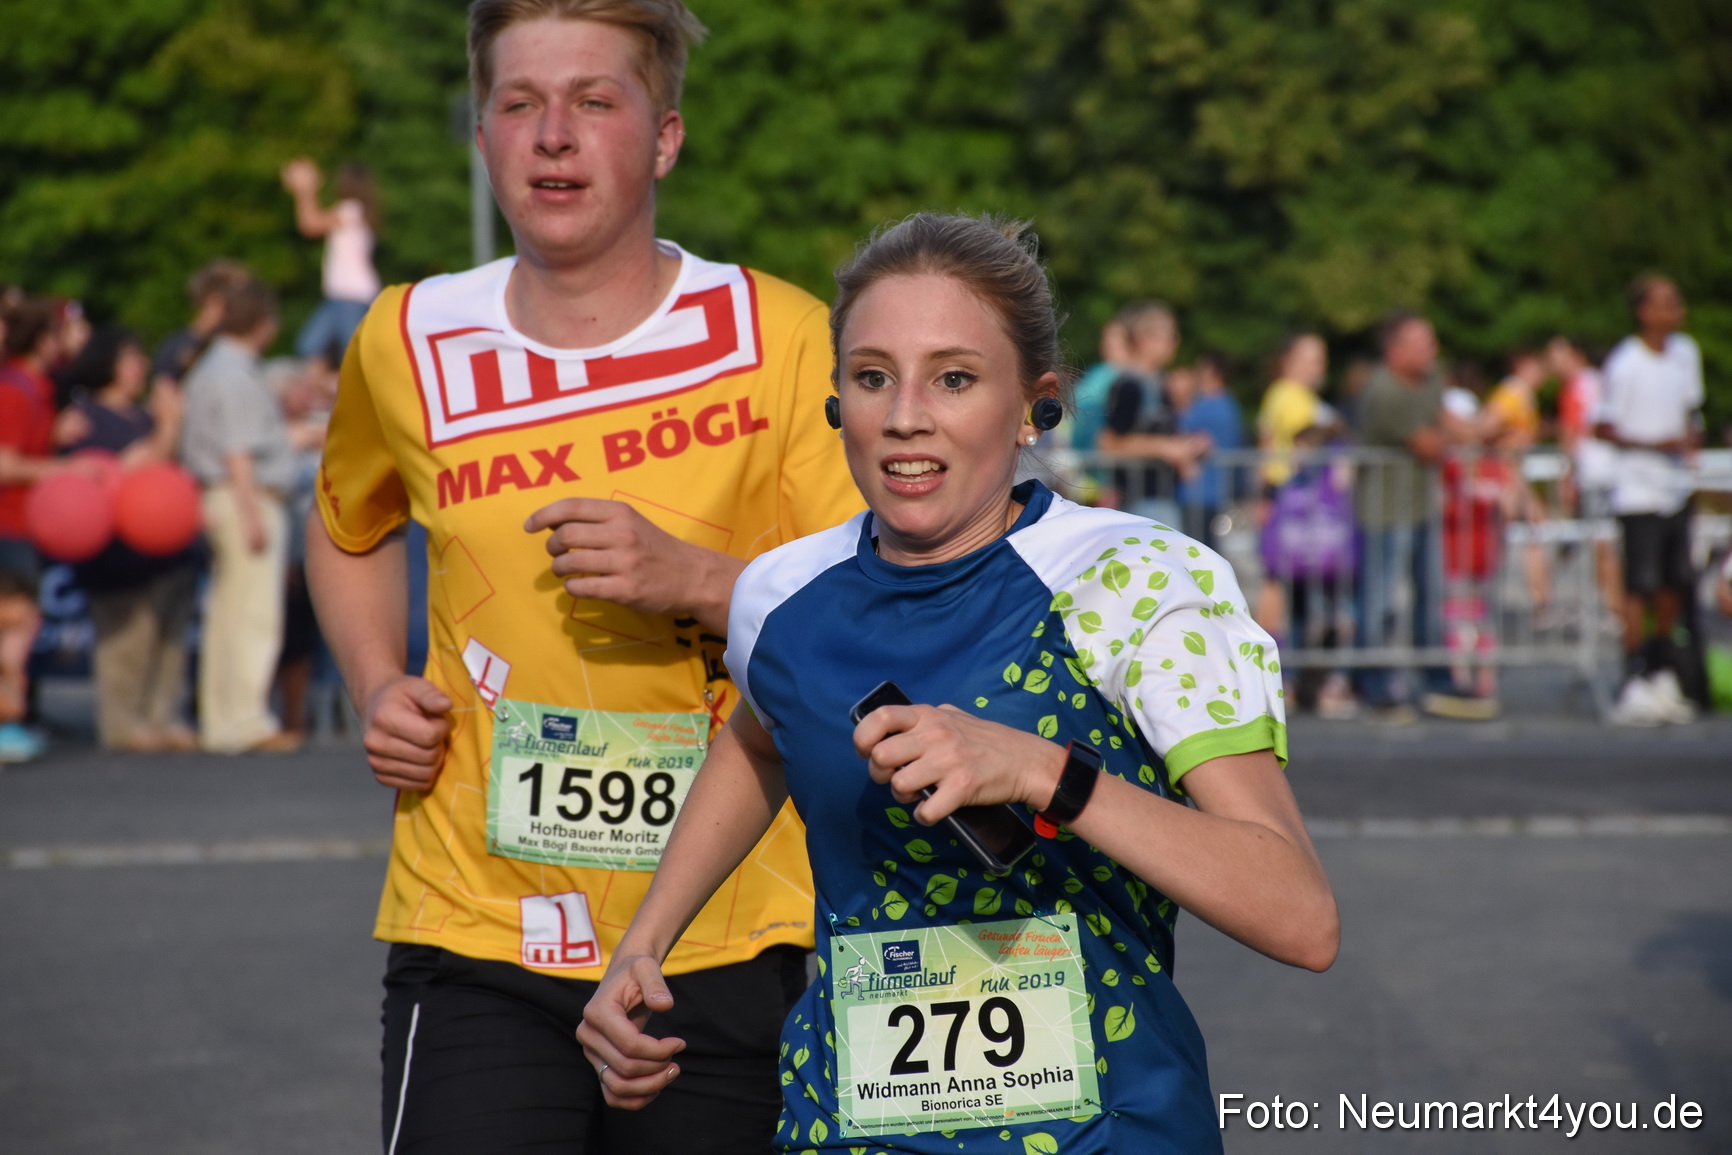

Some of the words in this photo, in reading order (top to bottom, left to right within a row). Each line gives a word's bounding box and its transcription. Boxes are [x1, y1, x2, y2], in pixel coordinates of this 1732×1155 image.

[437, 442, 582, 511] MAX
[601, 396, 770, 474] BÖGL
[525, 733, 610, 758] firmenlauf
[657, 755, 694, 770] 2019
[518, 762, 677, 828] 1598
[530, 821, 605, 842] Hofbauer
[609, 829, 660, 844] Moritz
[518, 836, 539, 847] Max
[542, 839, 568, 853] Bögl
[571, 842, 632, 856] Bauservice
[978, 928, 1023, 942] Gesunde
[1025, 930, 1062, 943] Firmen
[889, 950, 915, 959] Fischer
[998, 943, 1031, 958] laufen
[1034, 943, 1073, 962] länger!
[868, 965, 957, 992] firmenlauf
[1018, 970, 1066, 991] 2019
[869, 990, 908, 1000] neumarkt
[887, 996, 1026, 1076] 279
[857, 1081, 941, 1100] Widmann
[946, 1075, 997, 1094] Anna
[1002, 1066, 1074, 1089] Sophia
[921, 1097, 982, 1112] Bionorica
[984, 1094, 1004, 1106] SE
